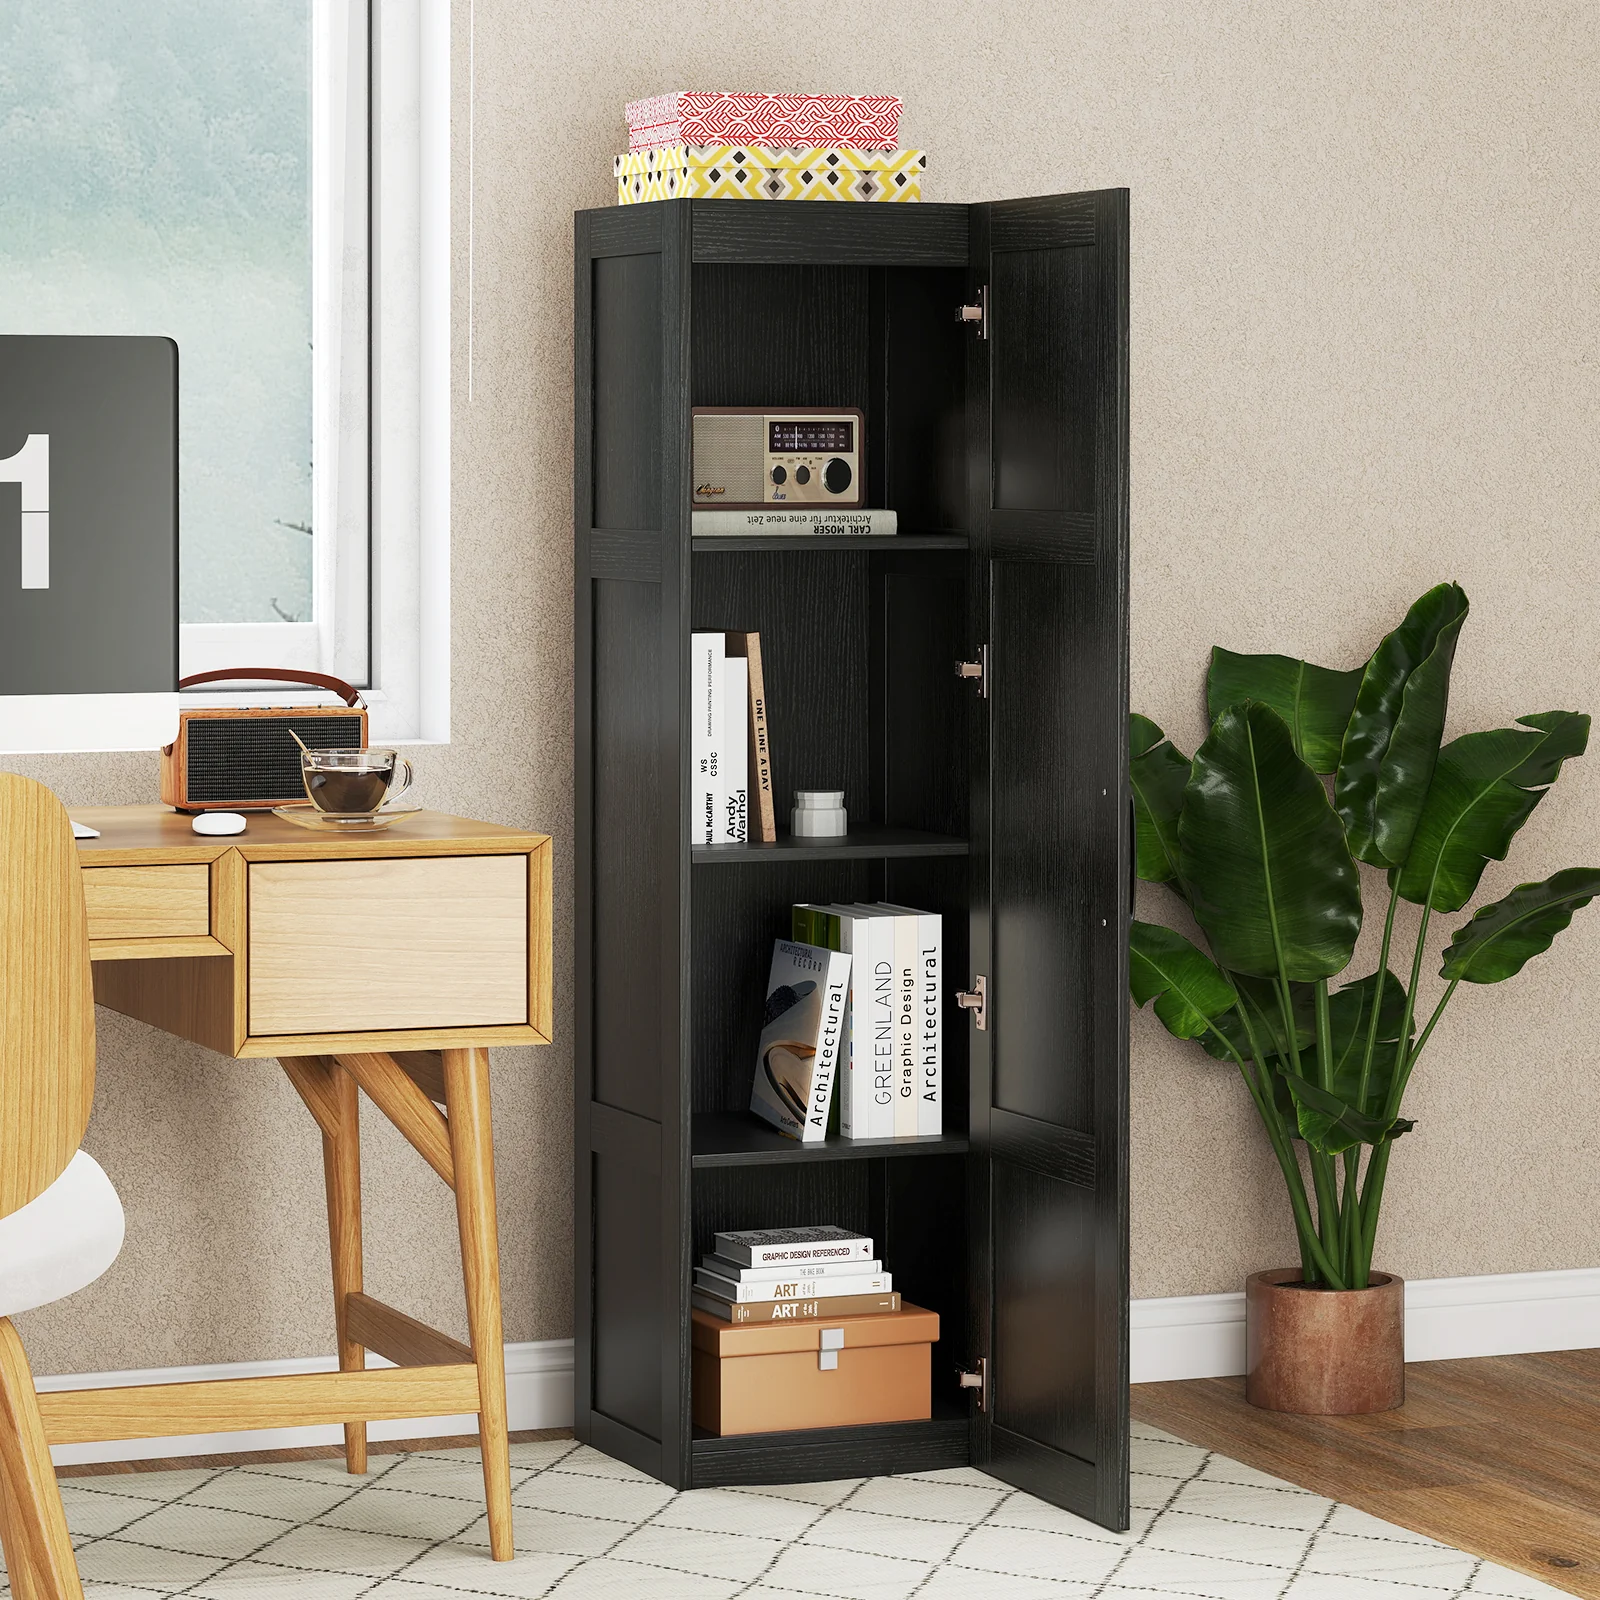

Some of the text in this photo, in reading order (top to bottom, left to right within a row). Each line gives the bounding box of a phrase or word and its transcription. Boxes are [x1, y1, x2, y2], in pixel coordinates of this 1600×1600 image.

[0, 434, 49, 589] 1
[747, 516, 764, 525] Zeit
[789, 516, 807, 524] eine
[810, 516, 822, 524] für
[825, 515, 871, 524] Architektur
[813, 526, 871, 534] CARL MOSER
[758, 727, 766, 753] LINE
[701, 759, 707, 772] WS
[726, 796, 738, 837] Andy
[736, 789, 746, 843] Warhol
[793, 956, 822, 972] RECORD
[923, 946, 936, 1102] Architectural
[875, 962, 892, 1104] GREENLAND
[901, 968, 914, 1097] Graphic Design
[810, 983, 843, 1126] Architectural
[762, 1252, 789, 1261] GRAPHIC
[790, 1250, 811, 1259] DESIGN
[812, 1247, 850, 1258] REFERENCED
[774, 1283, 798, 1297] ART
[772, 1303, 799, 1318] ART
